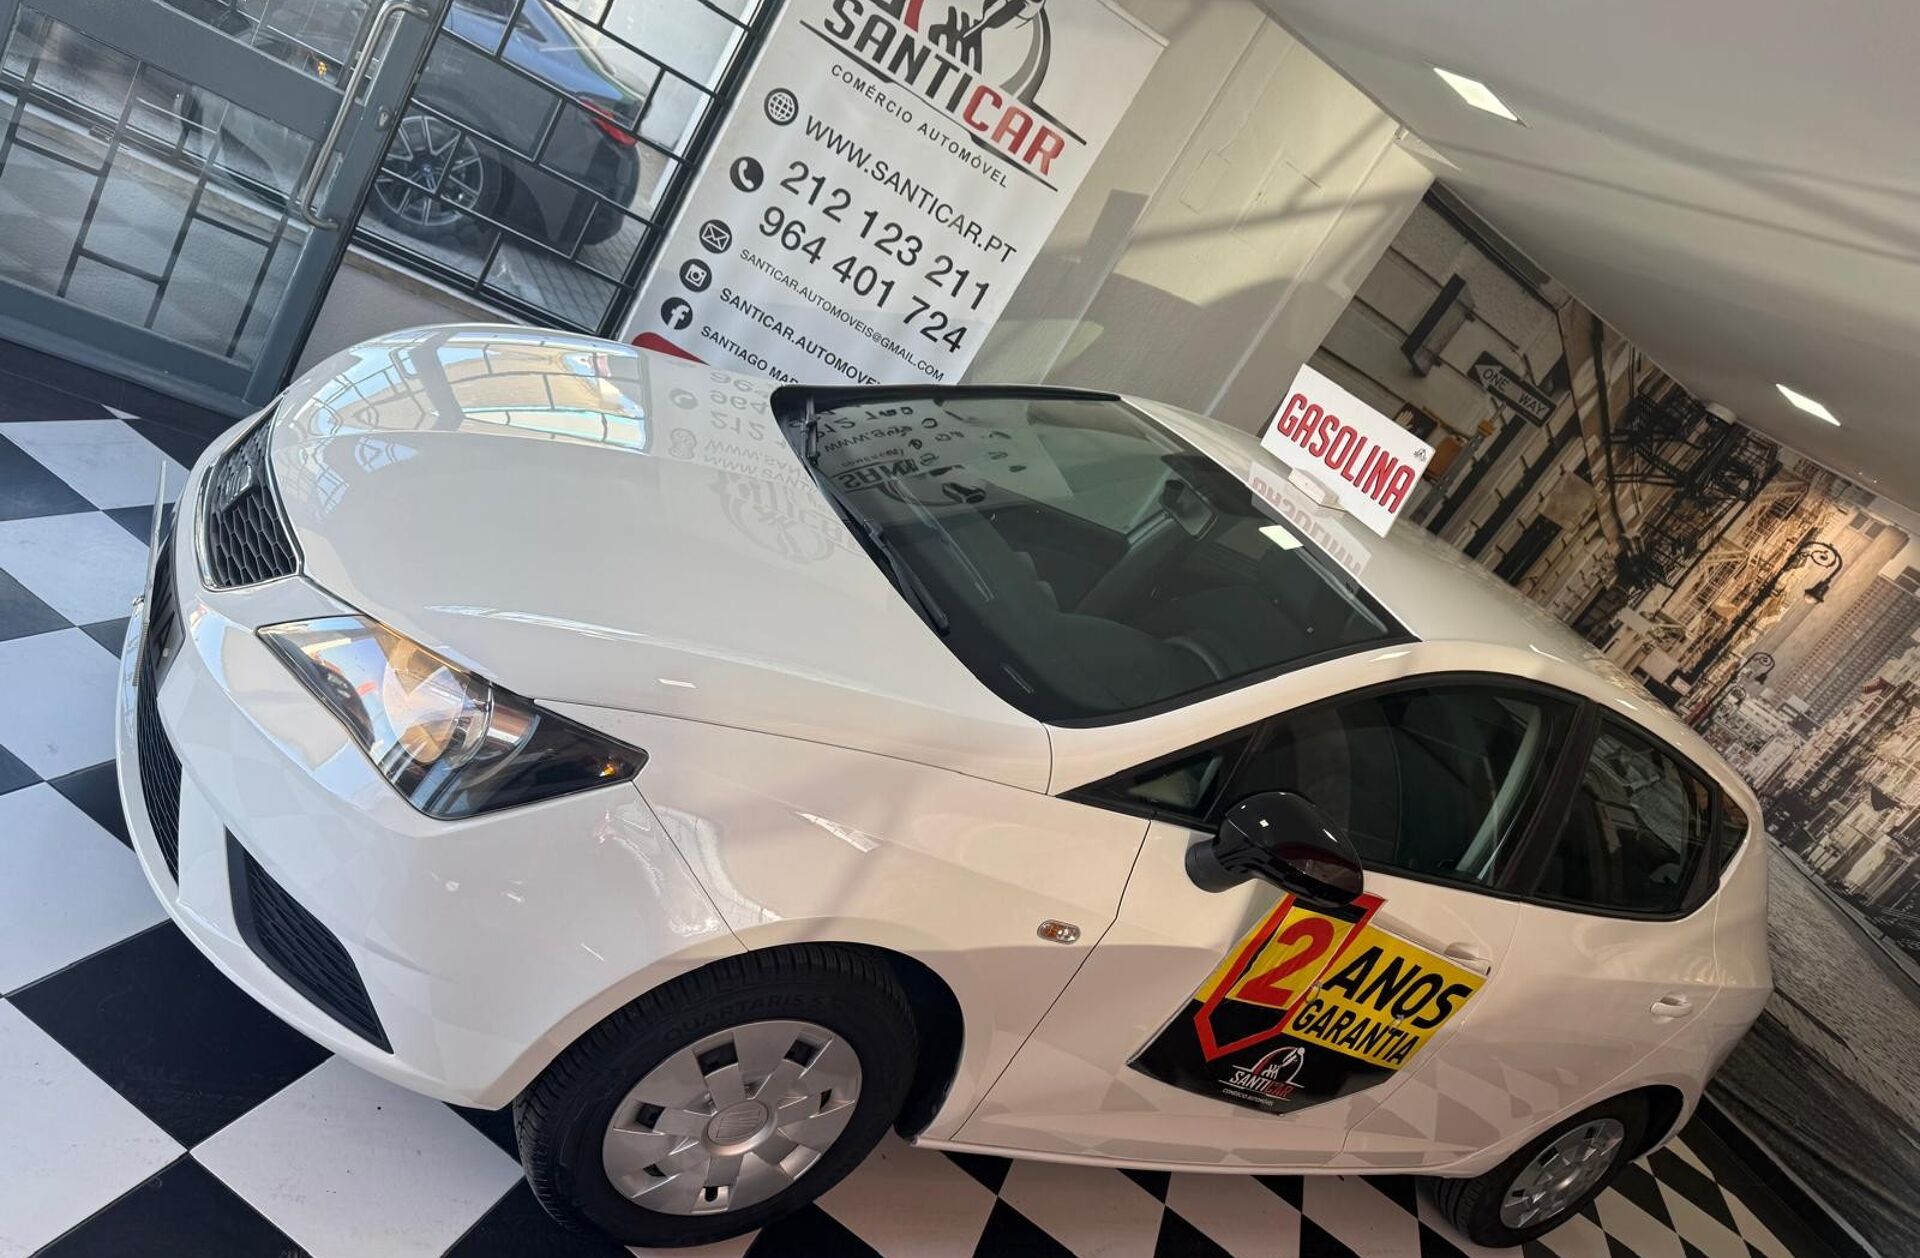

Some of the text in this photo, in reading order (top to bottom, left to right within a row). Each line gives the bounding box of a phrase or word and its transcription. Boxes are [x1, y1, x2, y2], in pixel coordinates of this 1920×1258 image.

[824, 0, 1065, 175] SANTICAR
[831, 64, 1008, 188] COMÉRCIO AUTOMÓVEL
[779, 161, 990, 310] 212 123 211
[805, 115, 1017, 264] WWW.SANTICAR.PT
[740, 249, 944, 381] SANTICAR.AUTOMOVEIS@GMAIL.COM
[759, 206, 968, 353] 964 401 724
[701, 325, 768, 371] SANTIAGO
[1483, 368, 1546, 415] ONE WAY
[1276, 393, 1416, 514] GASOLINA
[1235, 917, 1335, 1007] 2
[1322, 945, 1473, 1029] ANOS
[1229, 1070, 1297, 1098] SANTICAR
[1292, 999, 1421, 1065] GARANTIA
